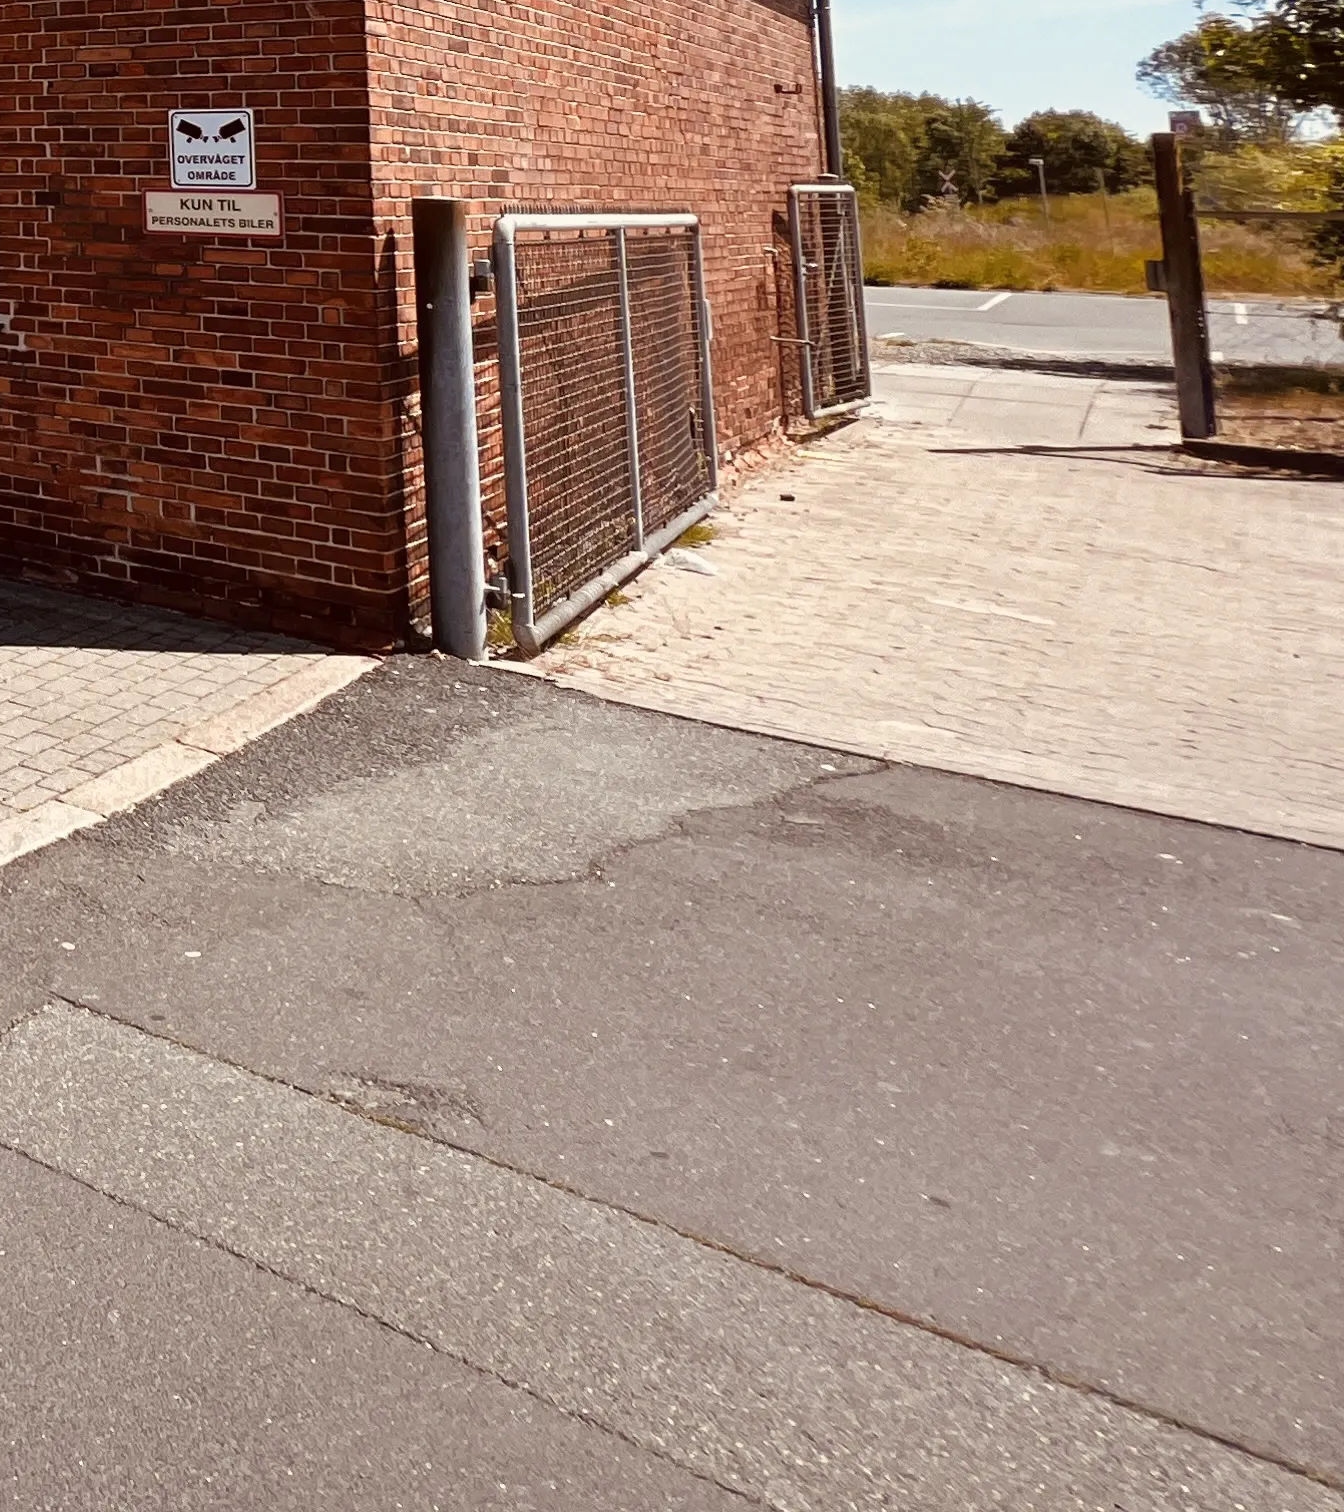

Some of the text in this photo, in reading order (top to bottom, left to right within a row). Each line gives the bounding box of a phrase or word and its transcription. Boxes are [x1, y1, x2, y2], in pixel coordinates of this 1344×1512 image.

[177, 153, 246, 165] OVERVÅGET
[187, 170, 237, 181] OMRÅDE
[180, 199, 242, 212] KUN TIL
[151, 216, 275, 229] PERSONALETS BILER
